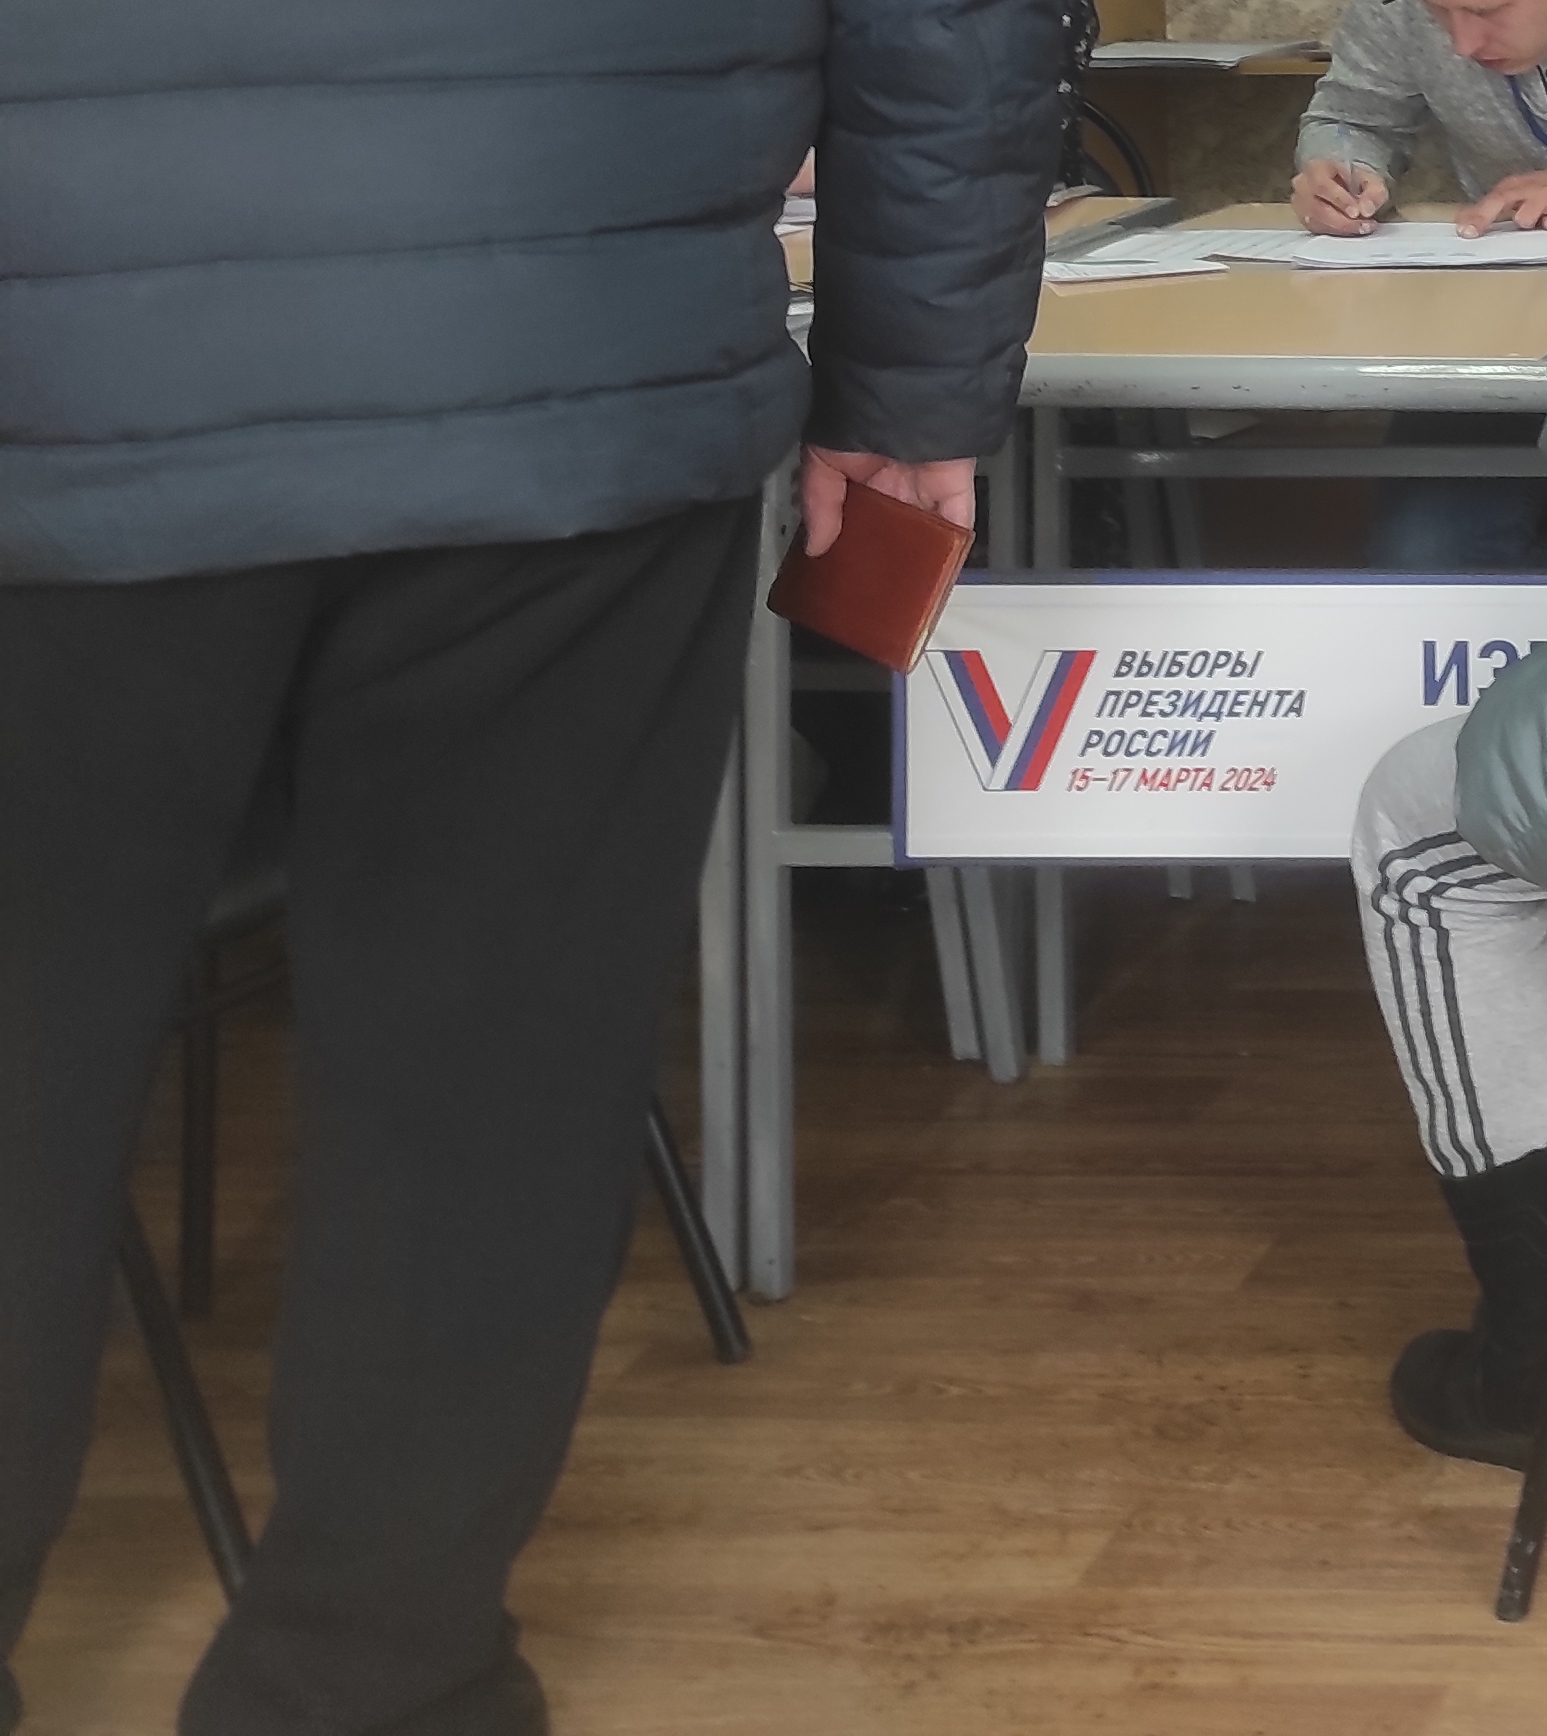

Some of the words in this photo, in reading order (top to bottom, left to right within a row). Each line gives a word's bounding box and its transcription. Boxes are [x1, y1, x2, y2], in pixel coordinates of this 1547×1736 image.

[1112, 649, 1263, 679] ВЫБОРЫ
[1096, 689, 1305, 721] ПРЕЗИДЕНТА
[1080, 730, 1214, 758] РОССИИ
[1134, 768, 1213, 792] МАРТА
[1219, 767, 1277, 792] 2024
